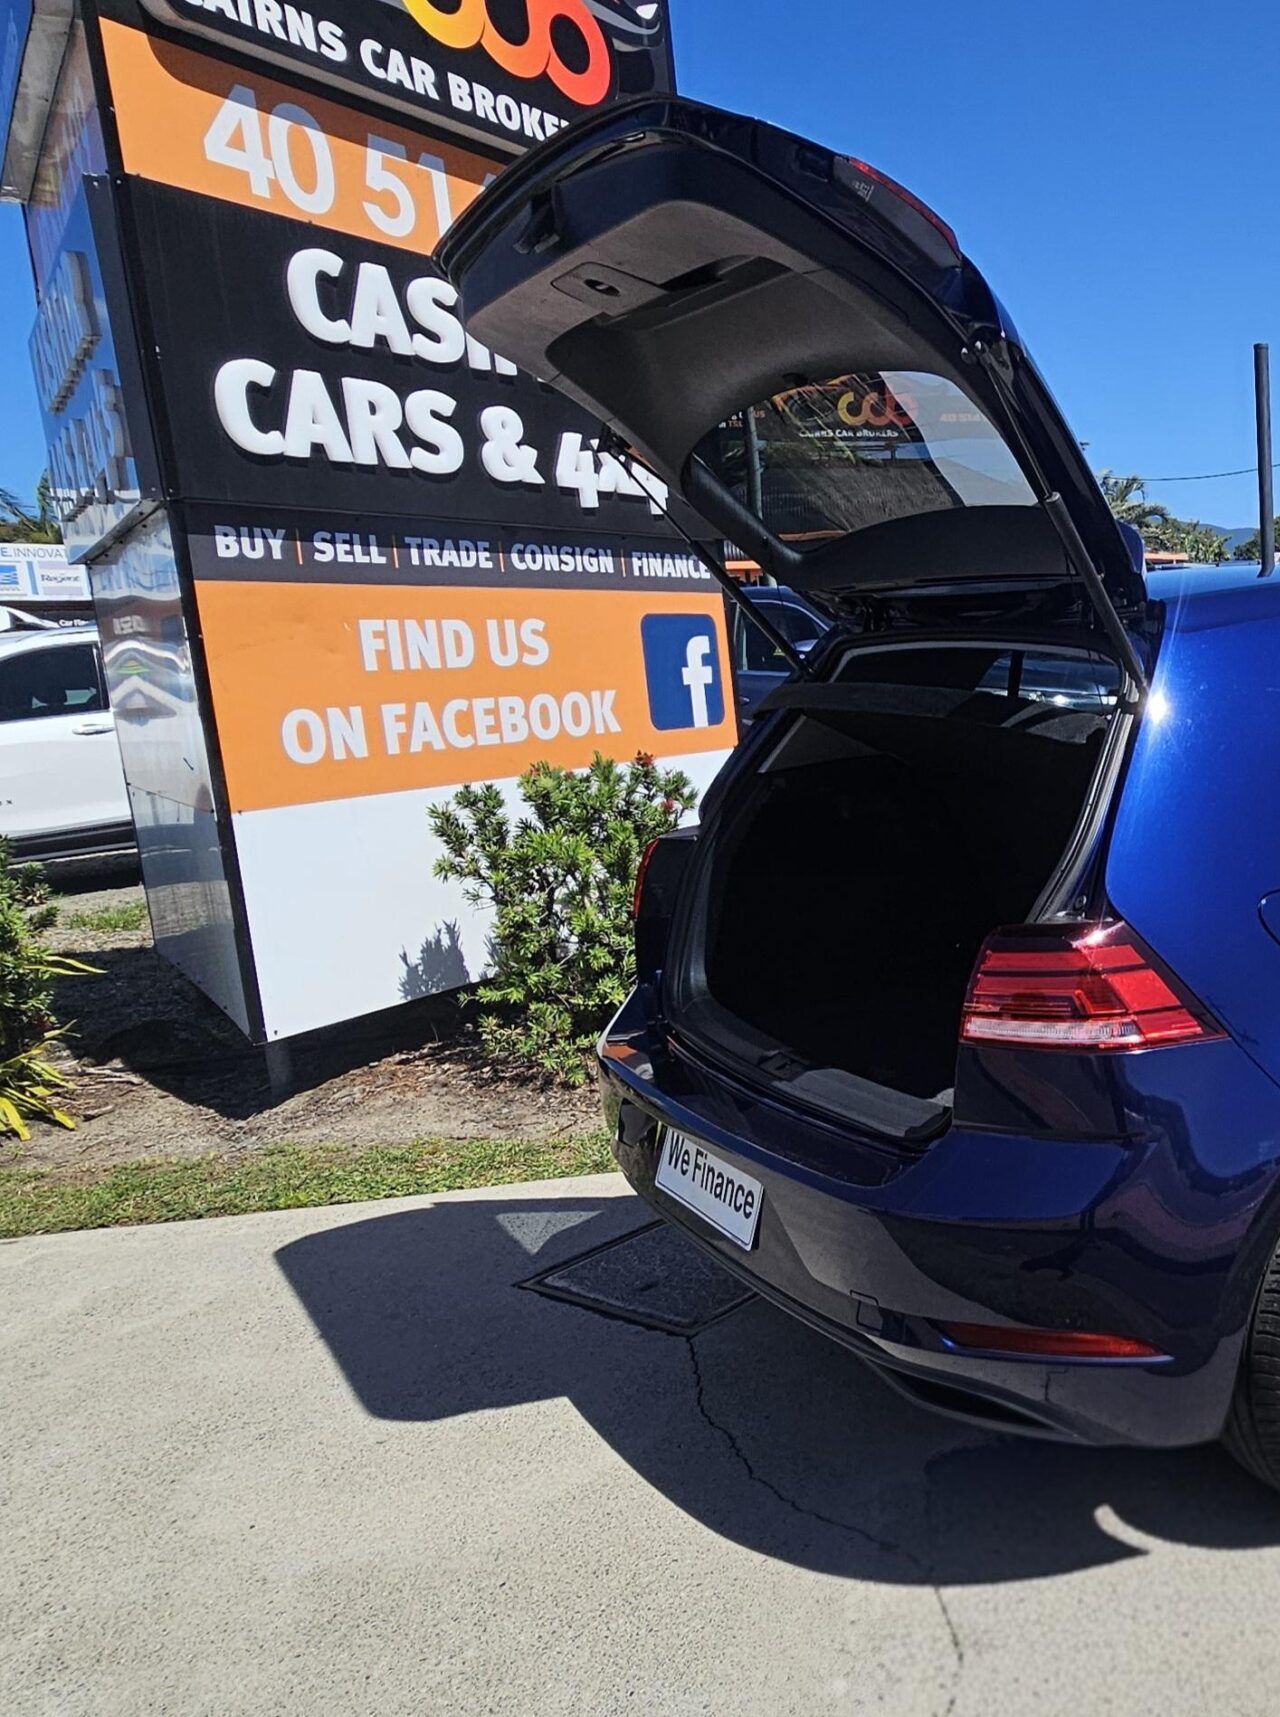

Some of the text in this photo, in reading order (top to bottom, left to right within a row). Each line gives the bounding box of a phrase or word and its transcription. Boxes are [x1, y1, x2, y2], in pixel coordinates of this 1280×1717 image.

[184, 0, 571, 142] AIRNS CAR BROKE
[203, 83, 335, 214] 40
[214, 358, 465, 475] CARS
[480, 405, 546, 485] &
[13, 547, 67, 558] INNOVA
[213, 524, 711, 580] BUY SELL TRADE CONSIGN FINANCE
[358, 618, 550, 672] FIND US
[281, 688, 622, 764] ON FACEBOOK
[667, 1131, 755, 1219] We Finance
